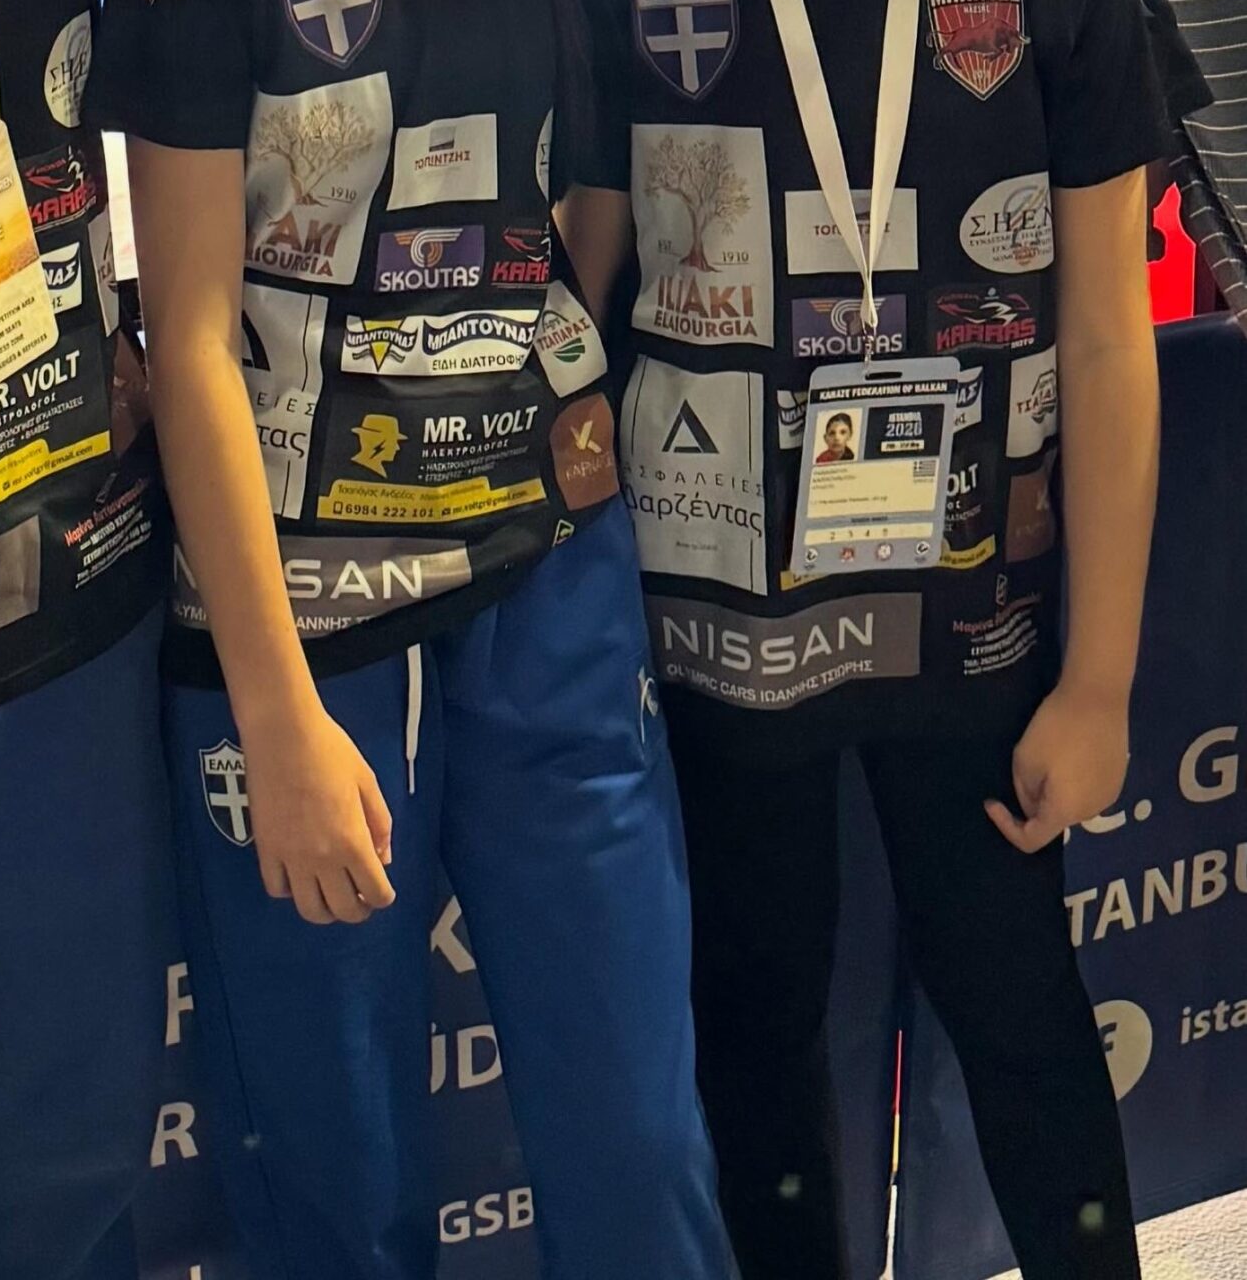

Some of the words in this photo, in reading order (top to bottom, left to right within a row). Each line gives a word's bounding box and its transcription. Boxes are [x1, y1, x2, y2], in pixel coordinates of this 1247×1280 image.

[330, 186, 358, 201] 1910
[721, 251, 750, 263] 1910
[379, 266, 481, 293] SKOUTAS
[658, 274, 754, 319] ILIAKI
[427, 318, 536, 351] ΜΠΑΝΤΟΥΝΑΣ
[654, 310, 758, 338] ELAIOURGIA
[347, 329, 415, 350] ΜΠΑΝΤΟΥΝΑΣ
[22, 350, 80, 398] VOLT
[819, 390, 850, 400] KARATE
[853, 385, 901, 398] FEDERATION
[915, 382, 948, 394] BALKAN
[423, 417, 473, 444] MR.
[482, 406, 538, 438] VOLT
[345, 503, 378, 516] 6984
[383, 505, 407, 517] 222
[412, 506, 434, 518] 101
[662, 612, 874, 675] NISSAN
[720, 682, 756, 702] CARS
